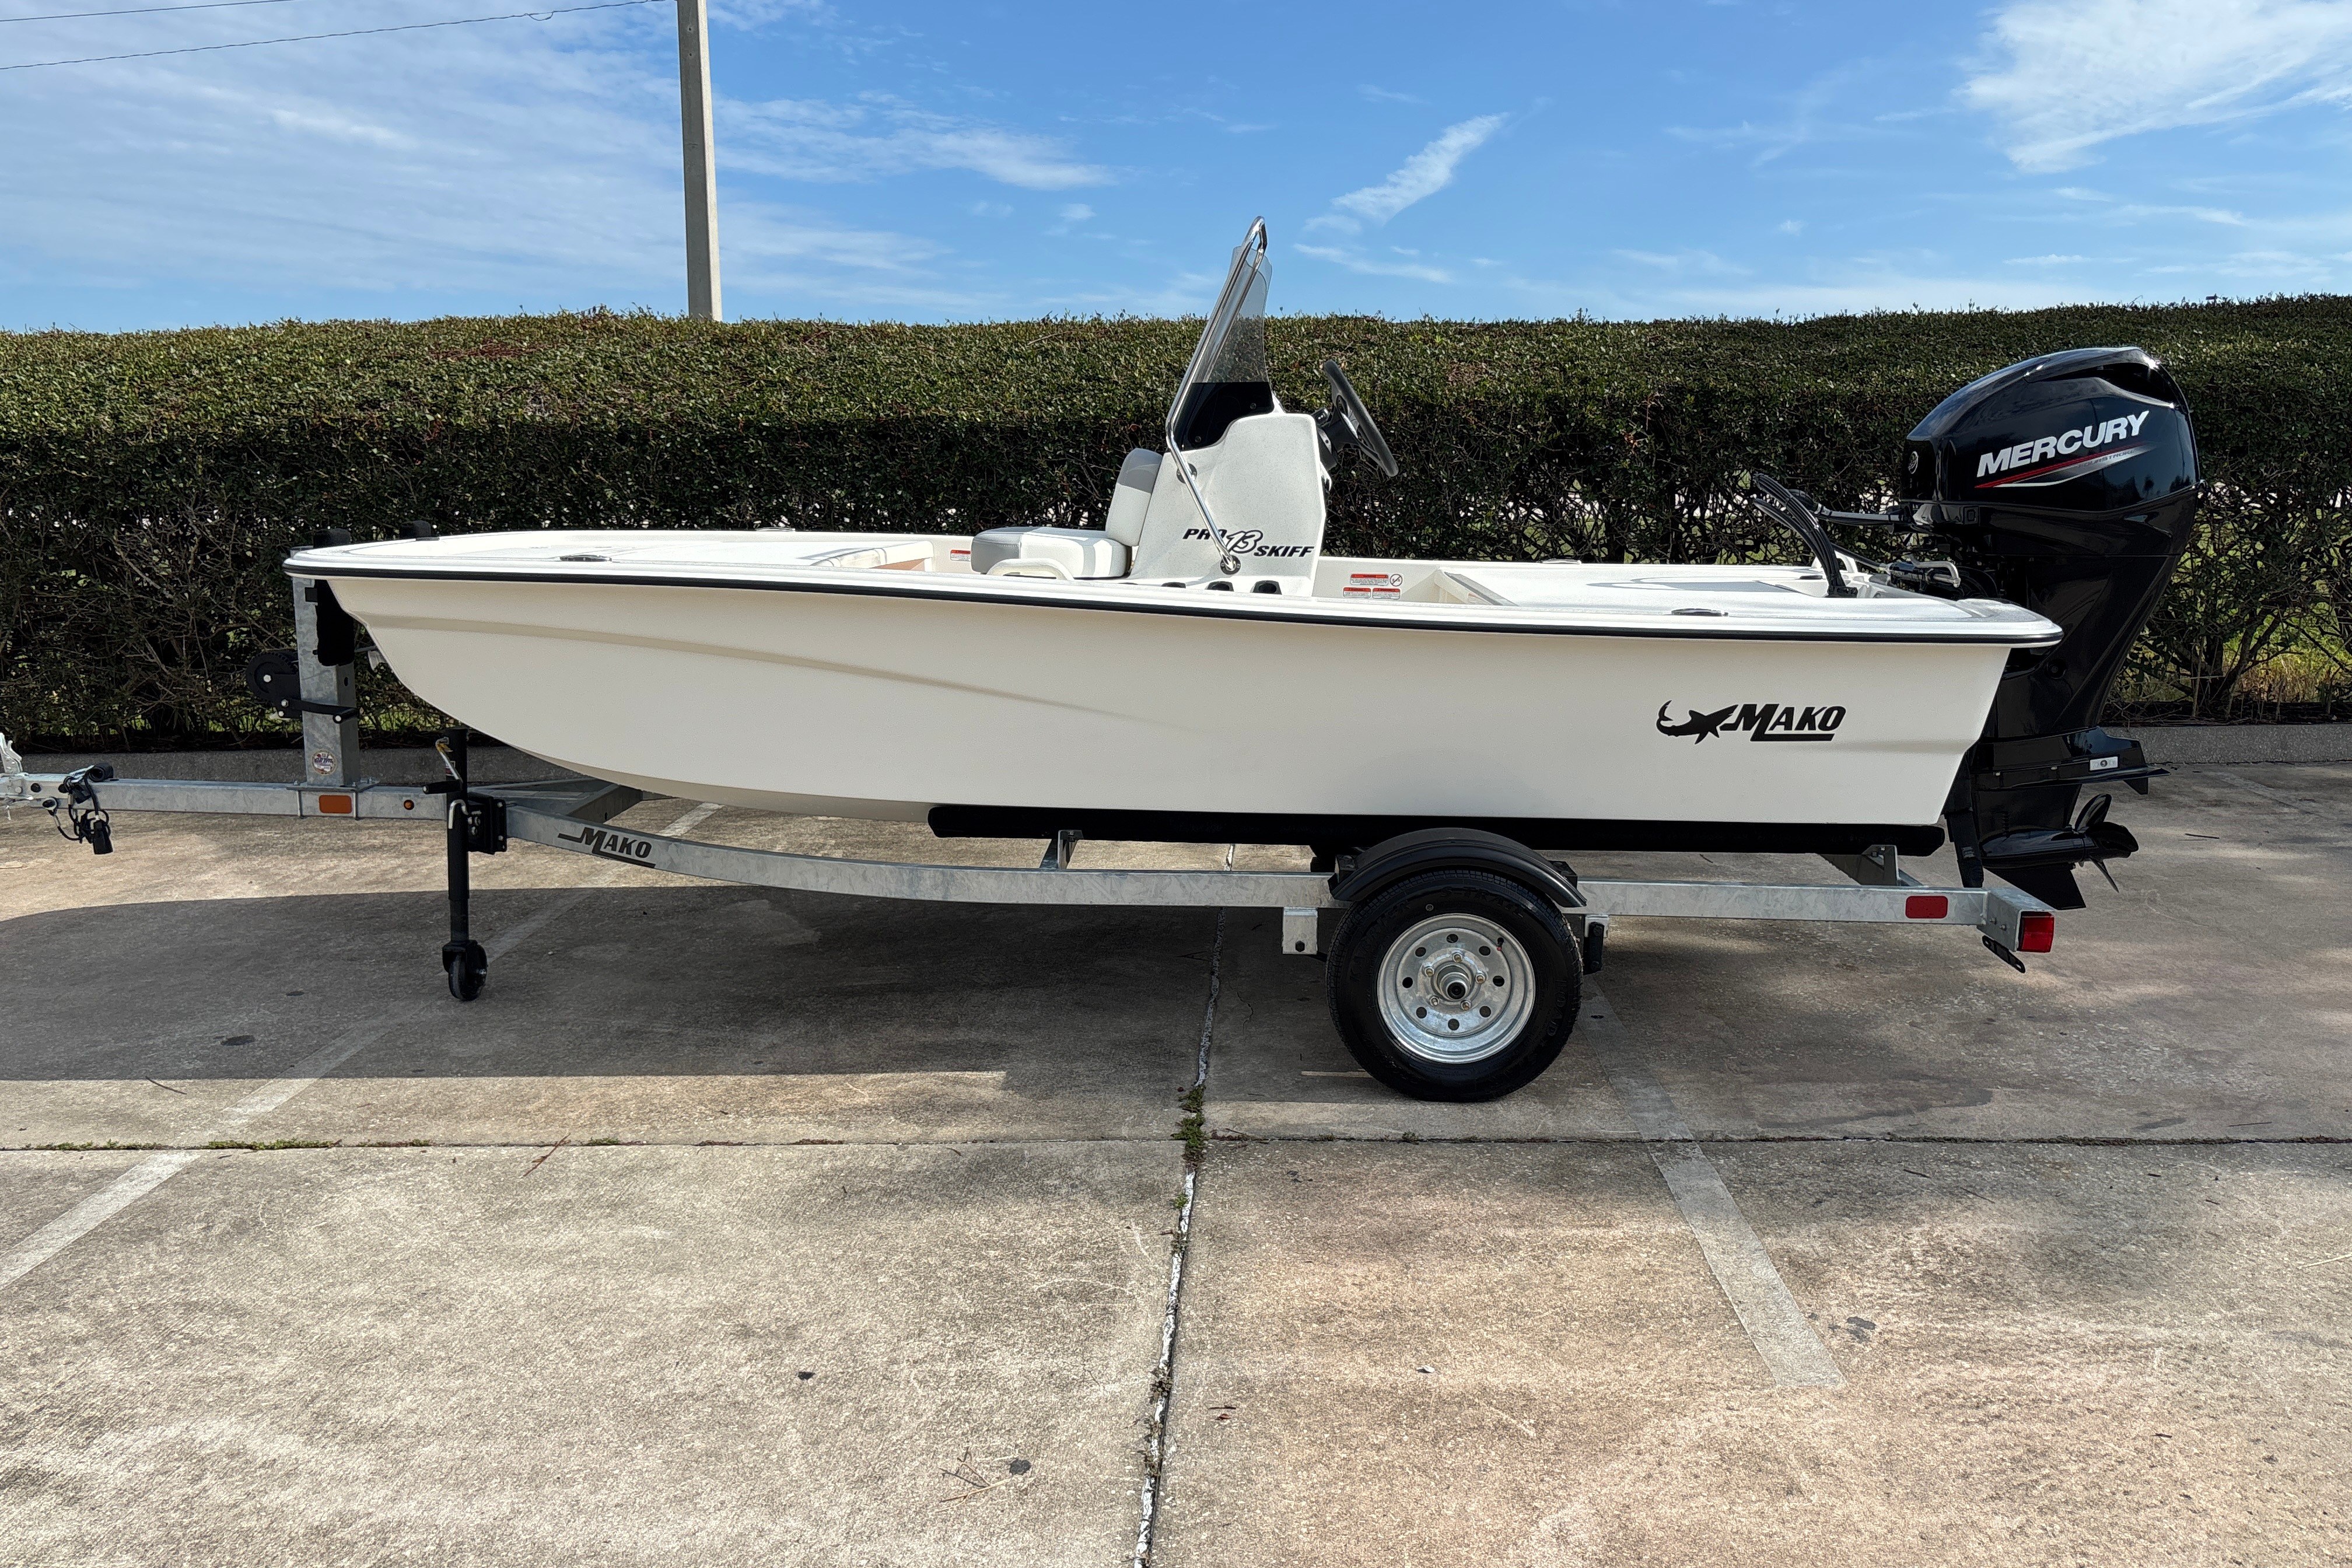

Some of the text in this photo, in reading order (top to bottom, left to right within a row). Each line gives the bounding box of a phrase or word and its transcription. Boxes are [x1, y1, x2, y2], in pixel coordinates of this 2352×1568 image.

[1976, 410, 2150, 478] MERCURY
[1226, 529, 1264, 554] 13
[1253, 545, 1315, 558] SKIFF
[1719, 703, 1847, 742] MAKO
[557, 827, 656, 869] MAKO
